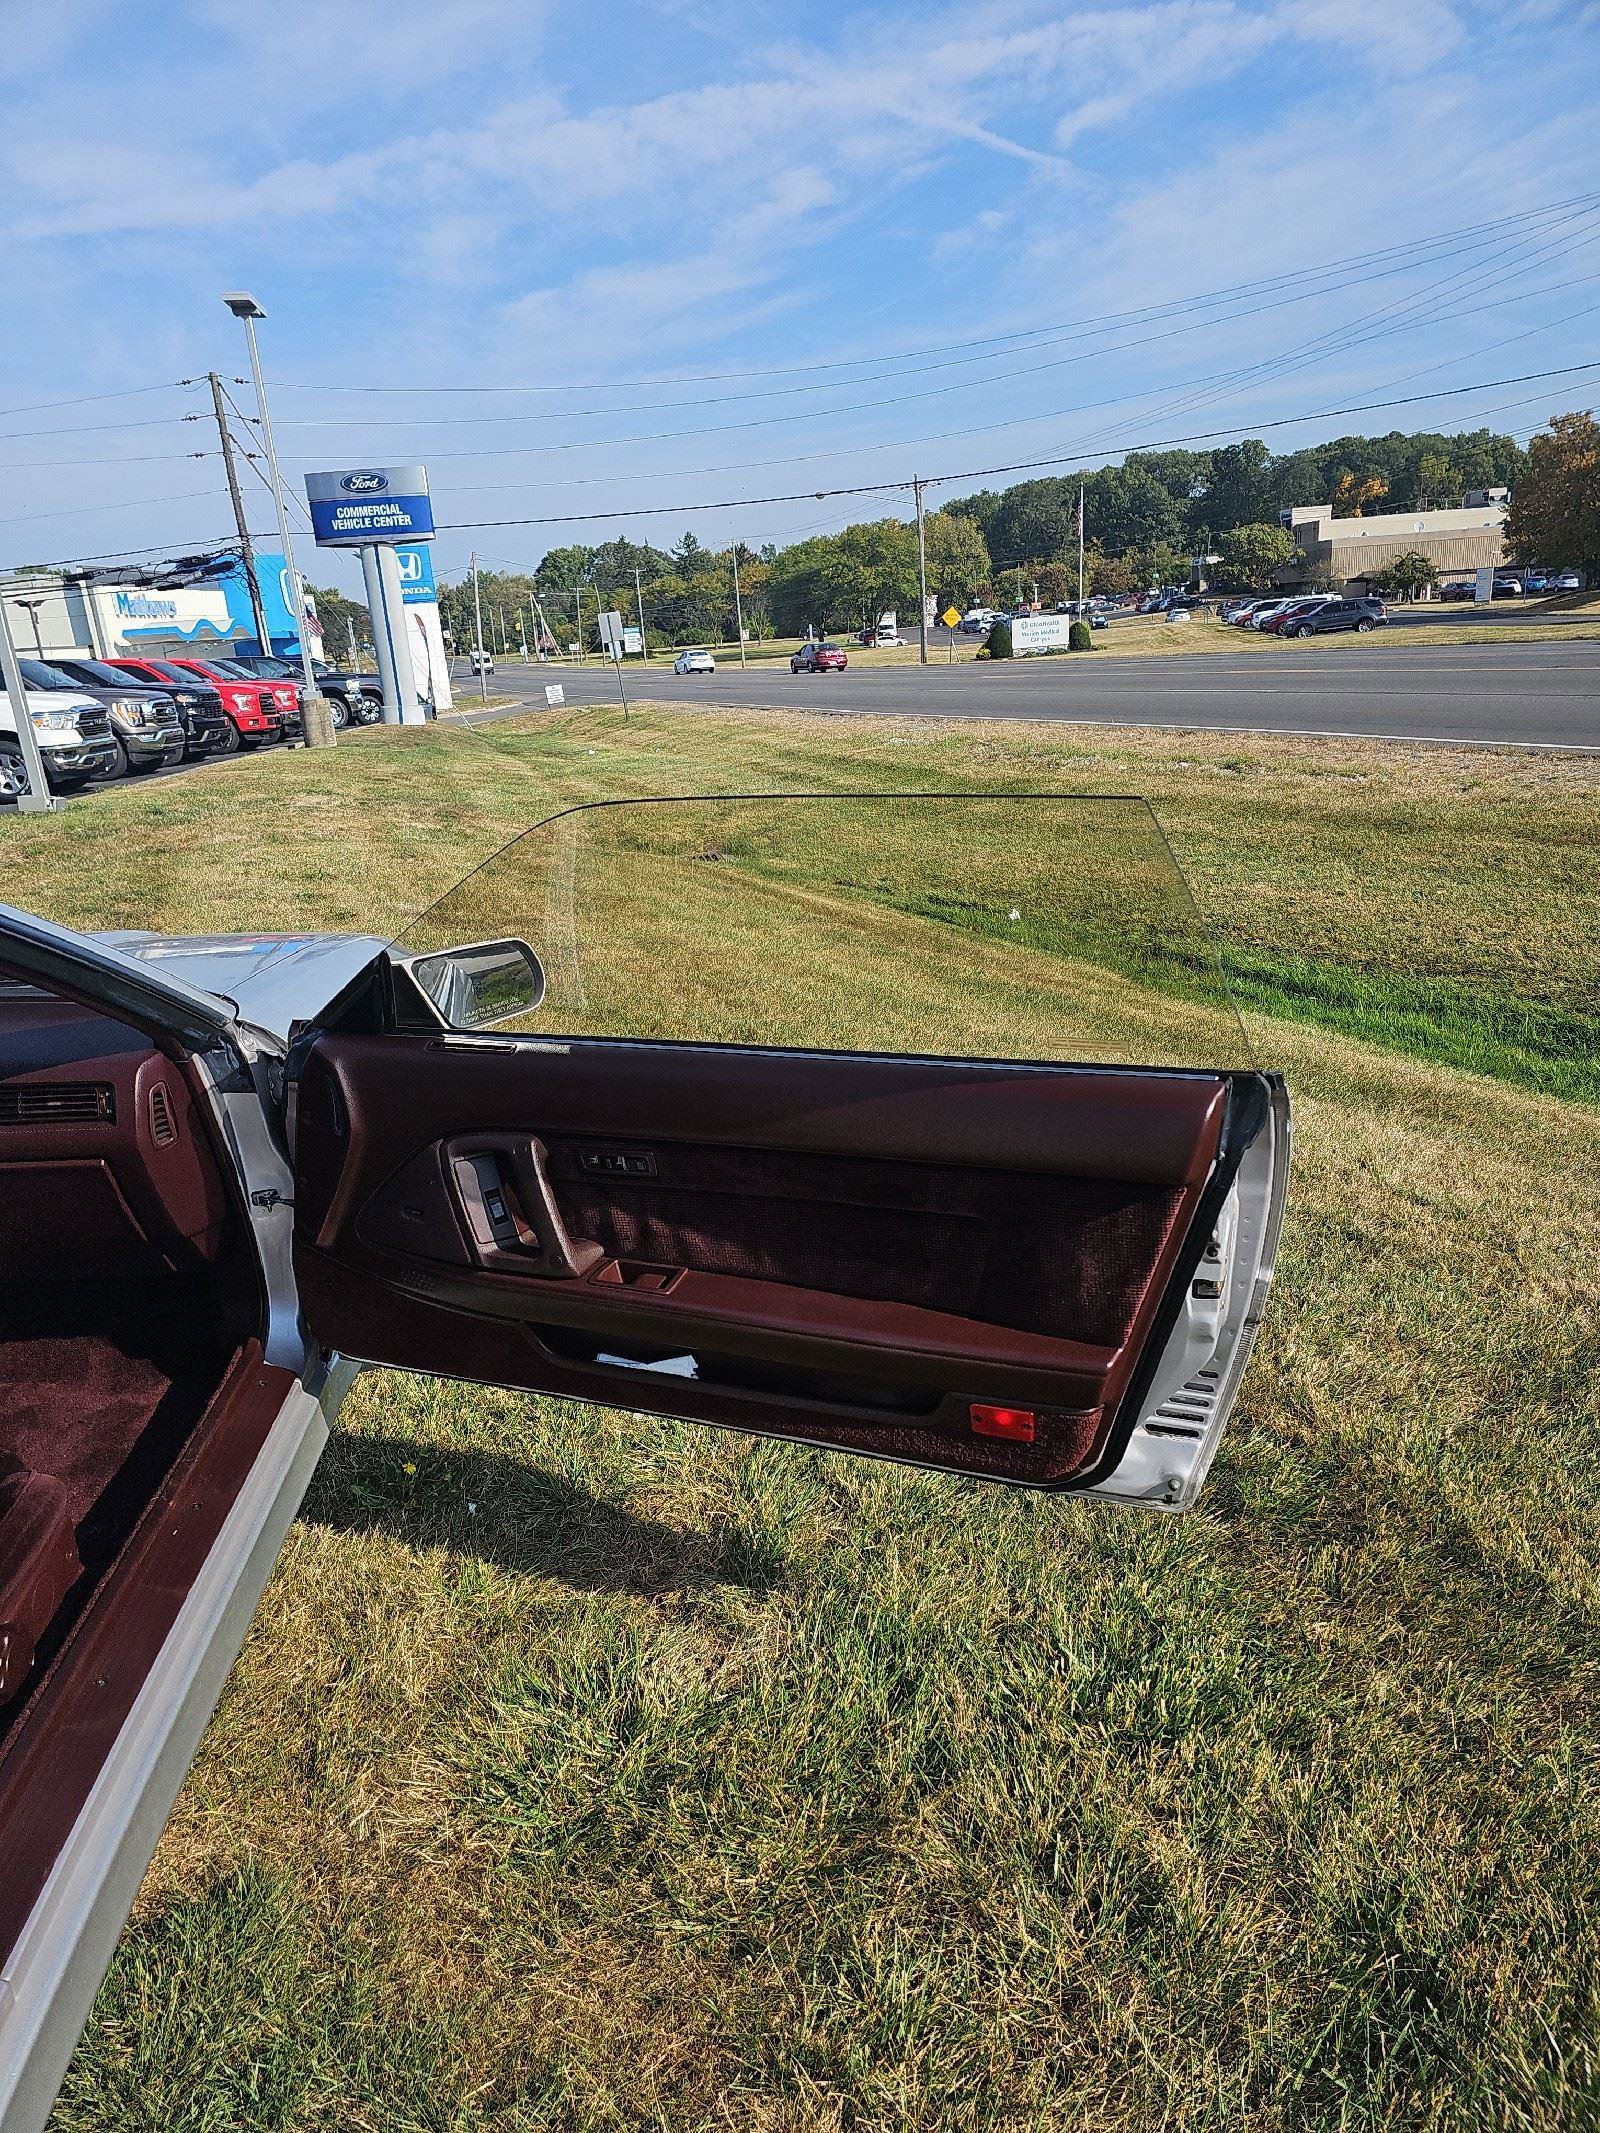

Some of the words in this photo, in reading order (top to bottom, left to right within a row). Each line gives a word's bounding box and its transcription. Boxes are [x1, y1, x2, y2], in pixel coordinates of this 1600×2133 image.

[350, 475, 379, 489] Ford
[336, 503, 403, 518] COMMERCIAL
[331, 517, 372, 531] VEHICLE
[373, 514, 412, 528] CENTER
